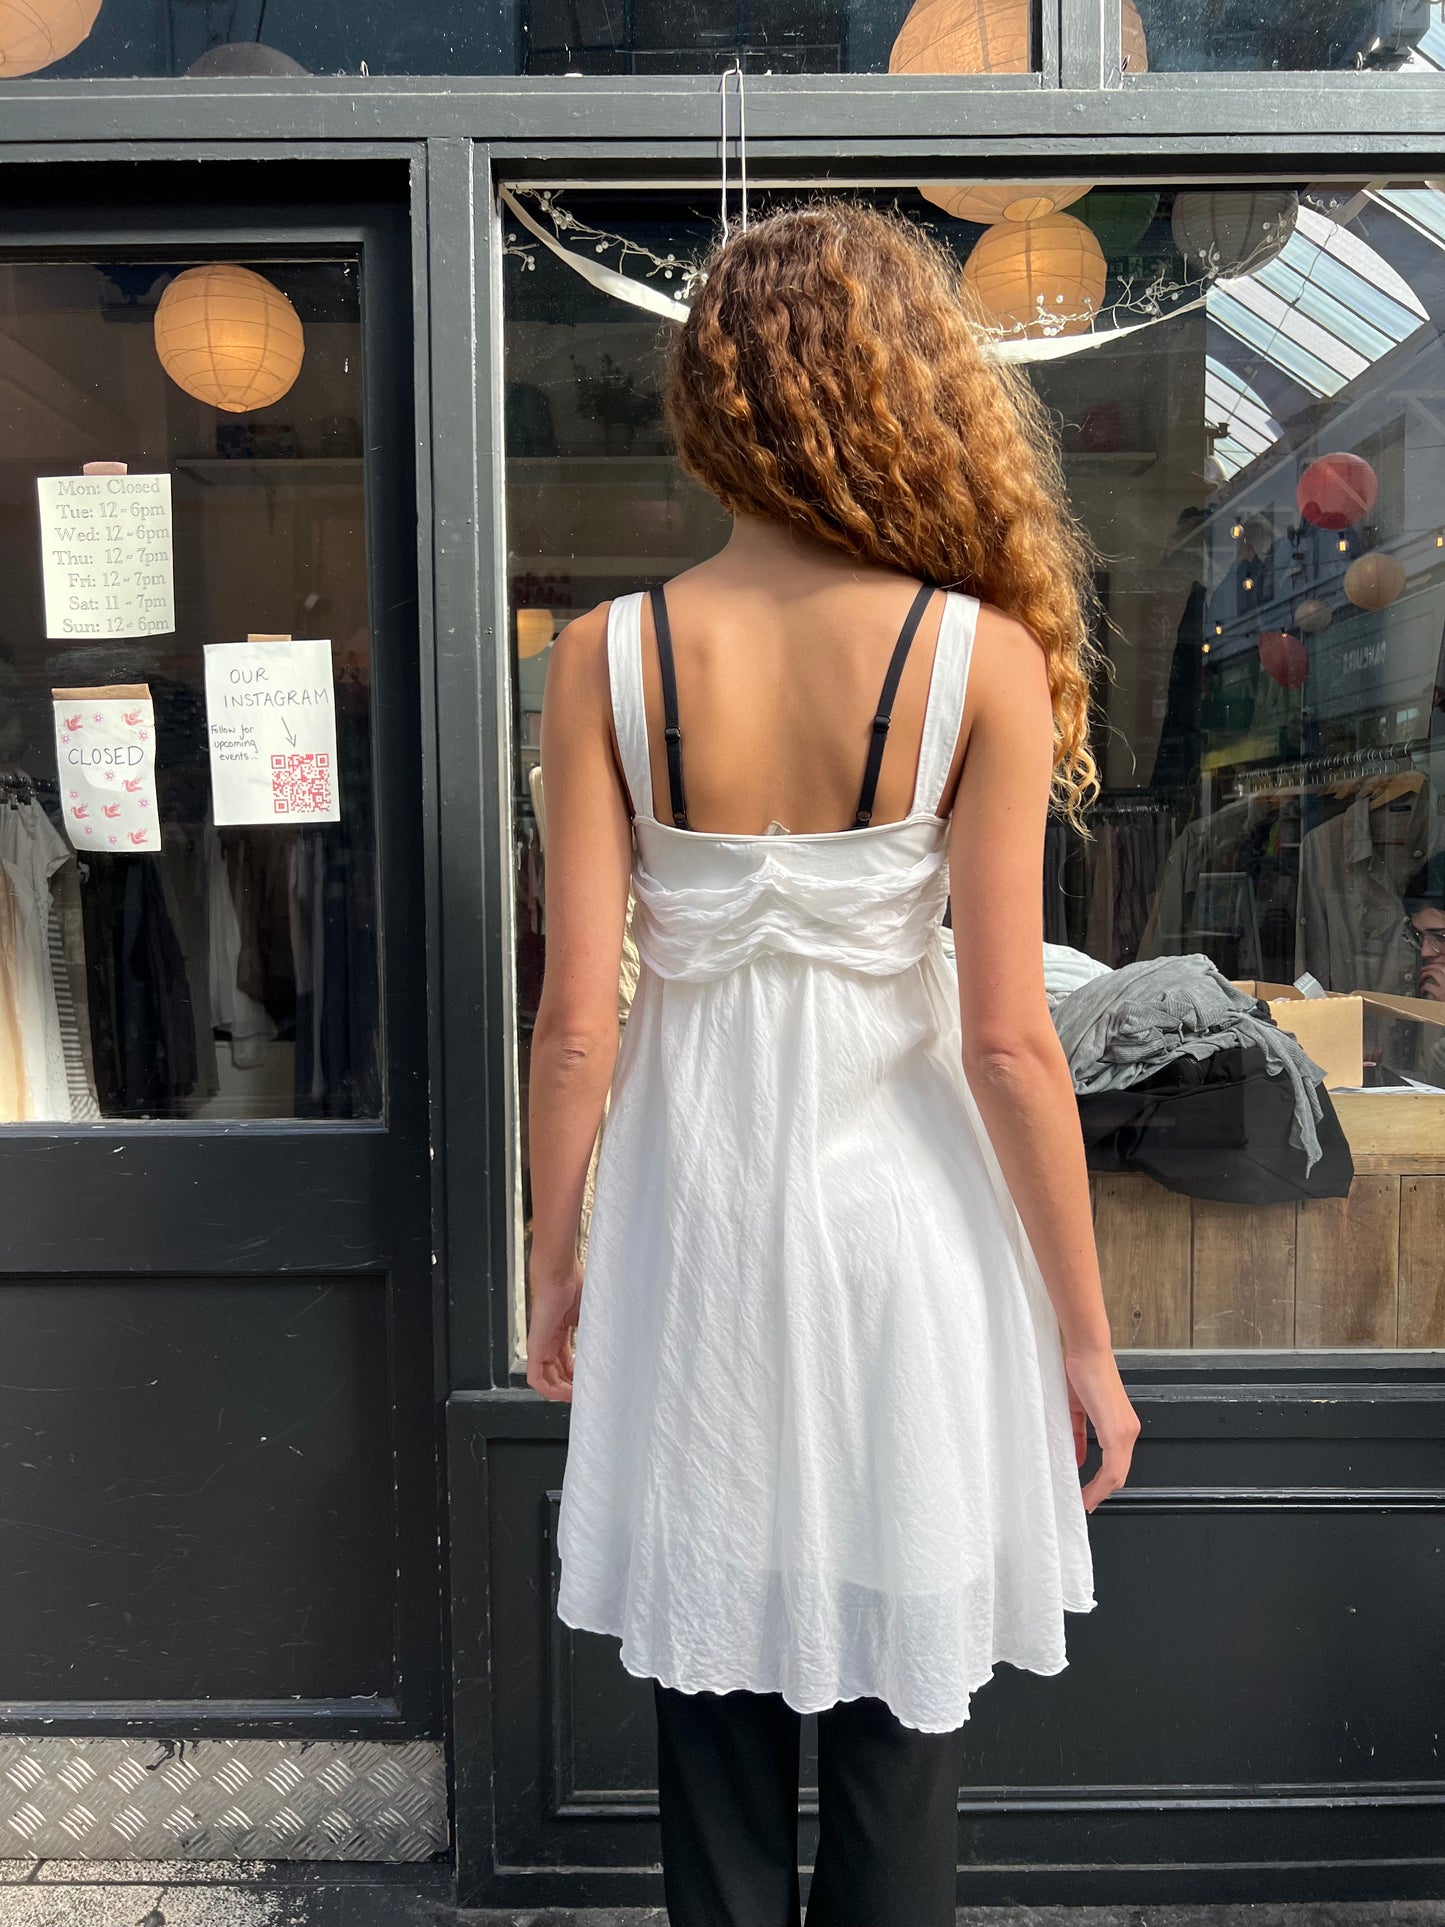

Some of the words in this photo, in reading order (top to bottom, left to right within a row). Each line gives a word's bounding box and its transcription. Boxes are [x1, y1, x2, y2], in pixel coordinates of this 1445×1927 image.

[58, 480, 101, 496] Mon:
[106, 478, 160, 495] Closed
[56, 504, 93, 519] Tue:
[54, 527, 100, 542] Wed:
[52, 550, 93, 565] Thu:
[68, 573, 96, 588] Fri:
[69, 595, 98, 611] Sat:
[62, 618, 100, 633] Sun:
[230, 667, 269, 684] OUR
[224, 688, 329, 708] INSTAGRAM
[211, 724, 236, 735] Follow
[240, 724, 254, 740] for
[214, 740, 258, 753] upcoming
[68, 745, 144, 766] CLOSED
